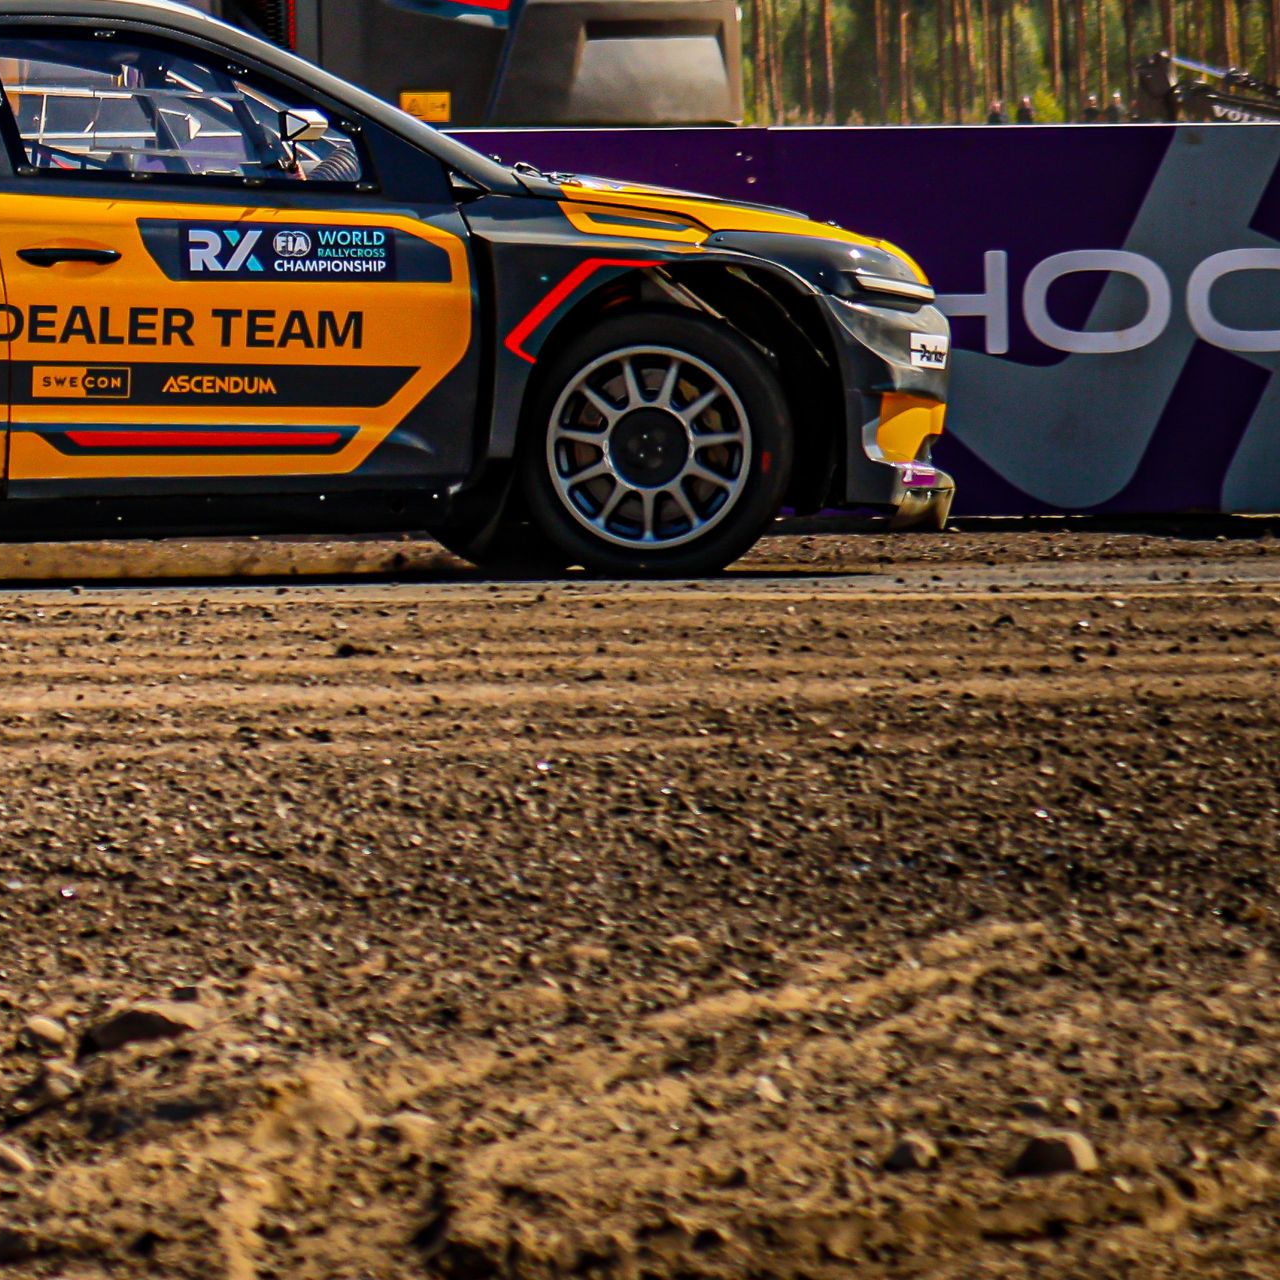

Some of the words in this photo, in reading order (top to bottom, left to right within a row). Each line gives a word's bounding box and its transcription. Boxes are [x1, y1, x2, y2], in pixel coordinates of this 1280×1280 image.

[188, 229, 265, 271] RX
[275, 234, 309, 254] FIA
[317, 231, 385, 246] WORLD
[317, 248, 386, 258] RALLYCROSS
[273, 260, 387, 272] CHAMPIONSHIP
[212, 308, 364, 349] TEAM
[162, 374, 277, 394] ASCENDUM
